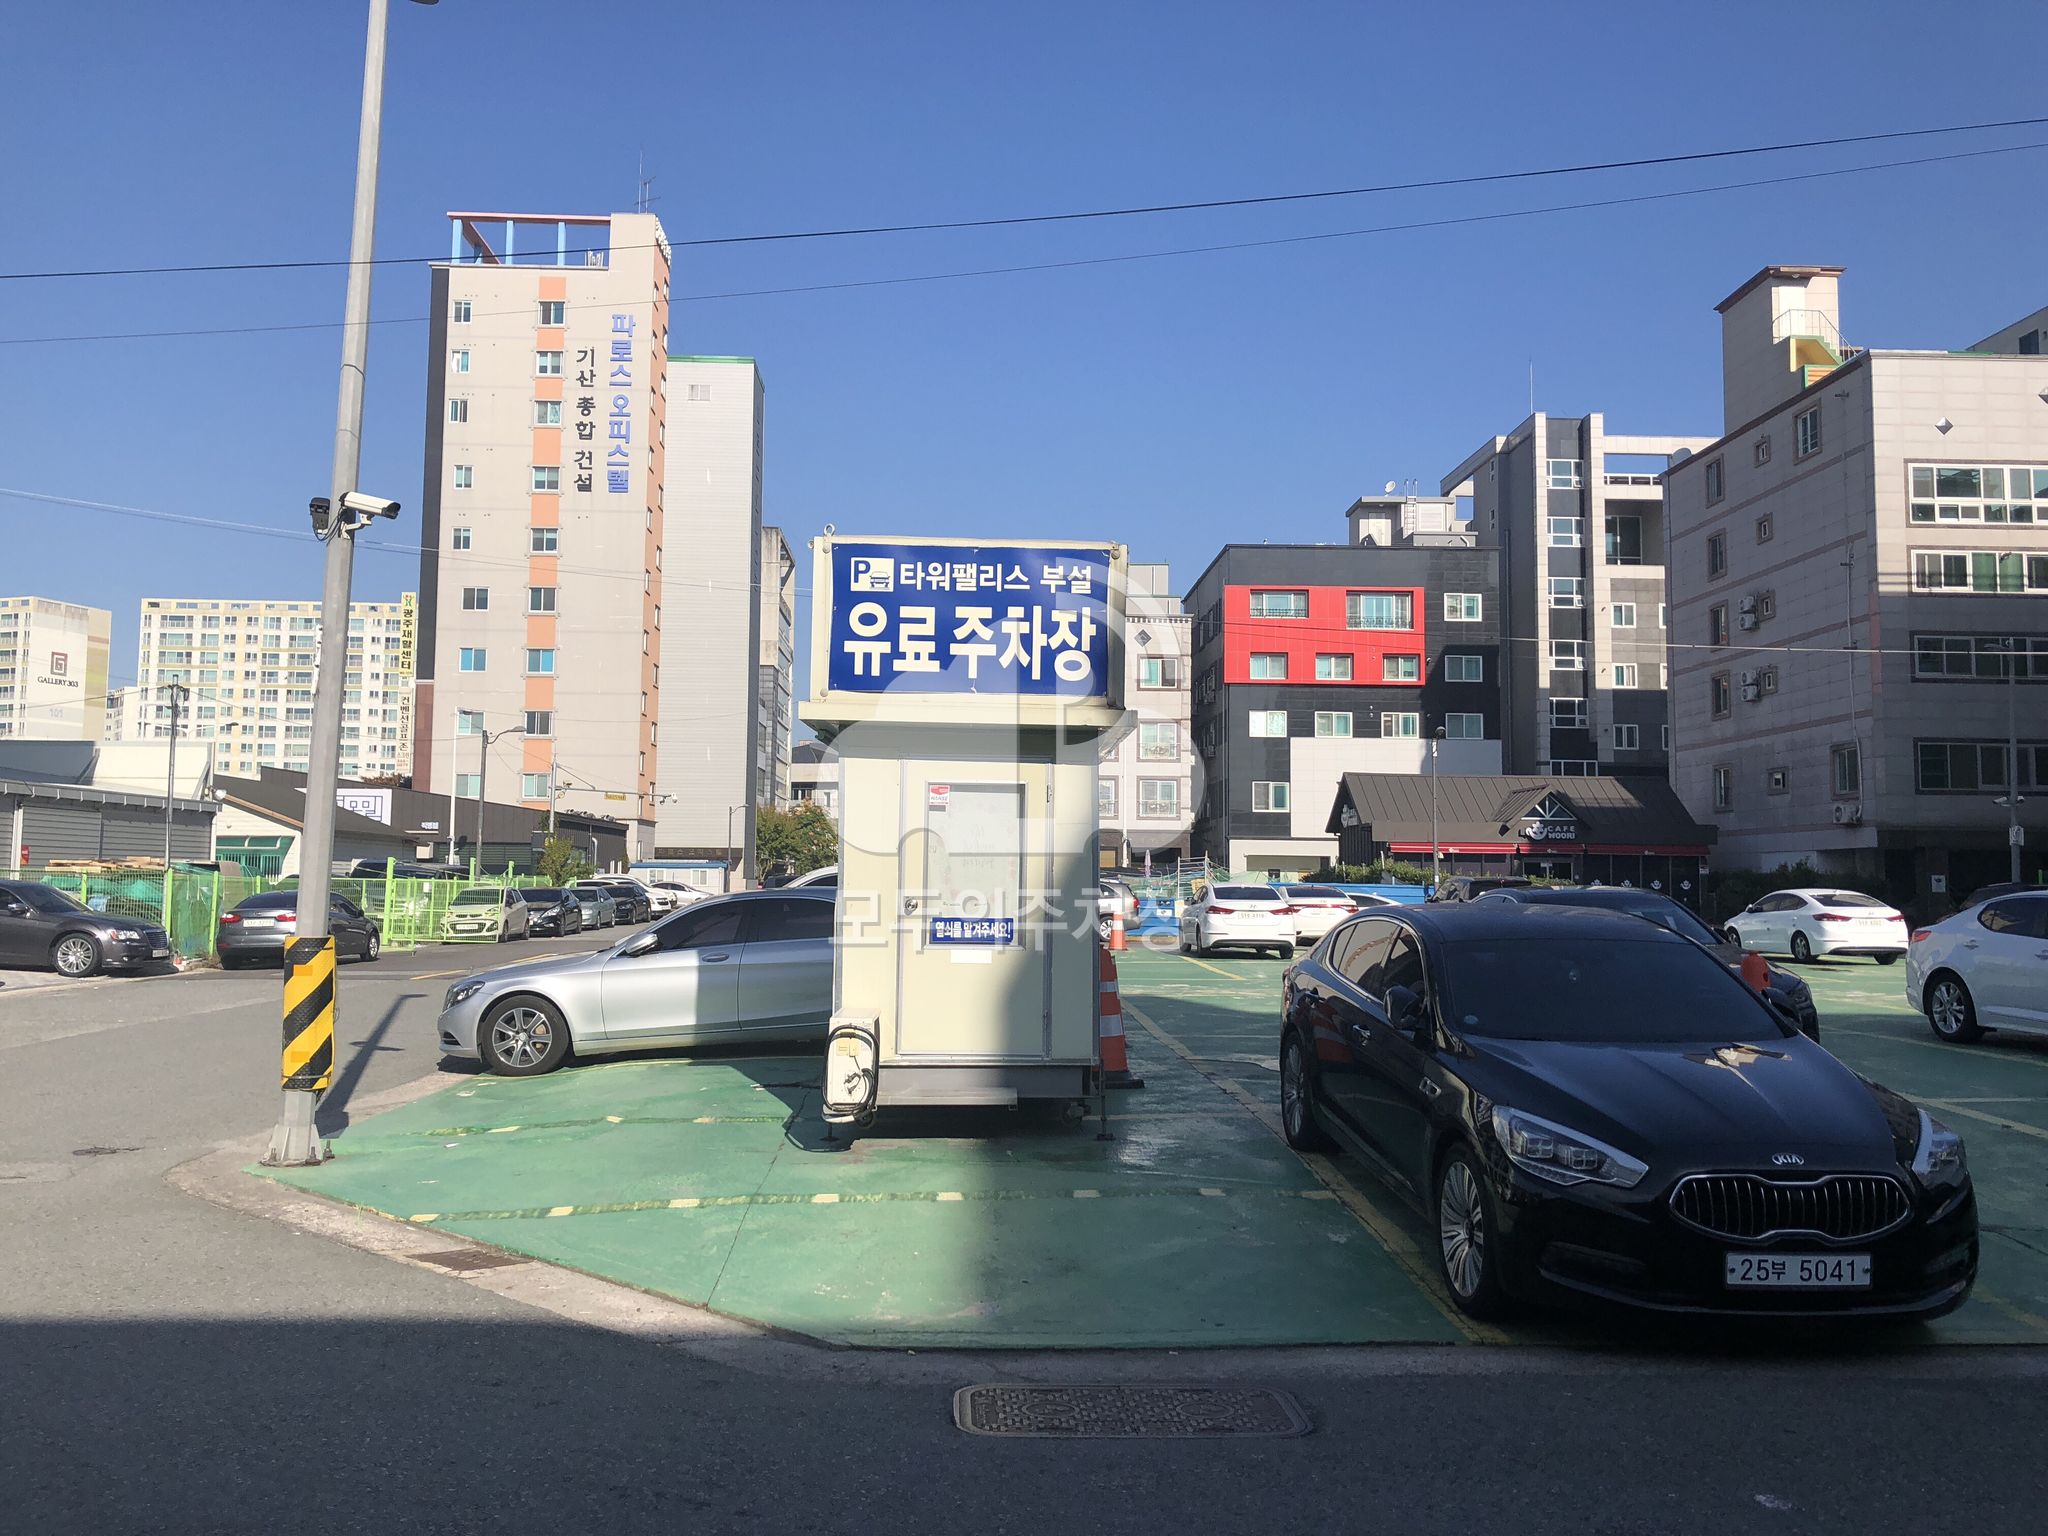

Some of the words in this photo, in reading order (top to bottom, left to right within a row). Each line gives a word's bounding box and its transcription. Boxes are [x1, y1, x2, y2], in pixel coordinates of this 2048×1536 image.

[575, 346, 597, 388] 기산
[609, 313, 636, 388] 파로스
[575, 395, 596, 441] 종합
[606, 395, 632, 493] 오피스텔
[573, 450, 594, 493] 건설
[898, 560, 1031, 593] 타워팰리스
[1039, 563, 1093, 595] 부설
[37, 676, 66, 686] GALLERY
[66, 680, 79, 688] 303
[934, 921, 962, 938] 열쇠를
[963, 921, 1011, 939] 맡겨주세요!
[1774, 1153, 1802, 1165] KIA
[1739, 1258, 1787, 1281] 25부
[1799, 1258, 1858, 1281] 5041
